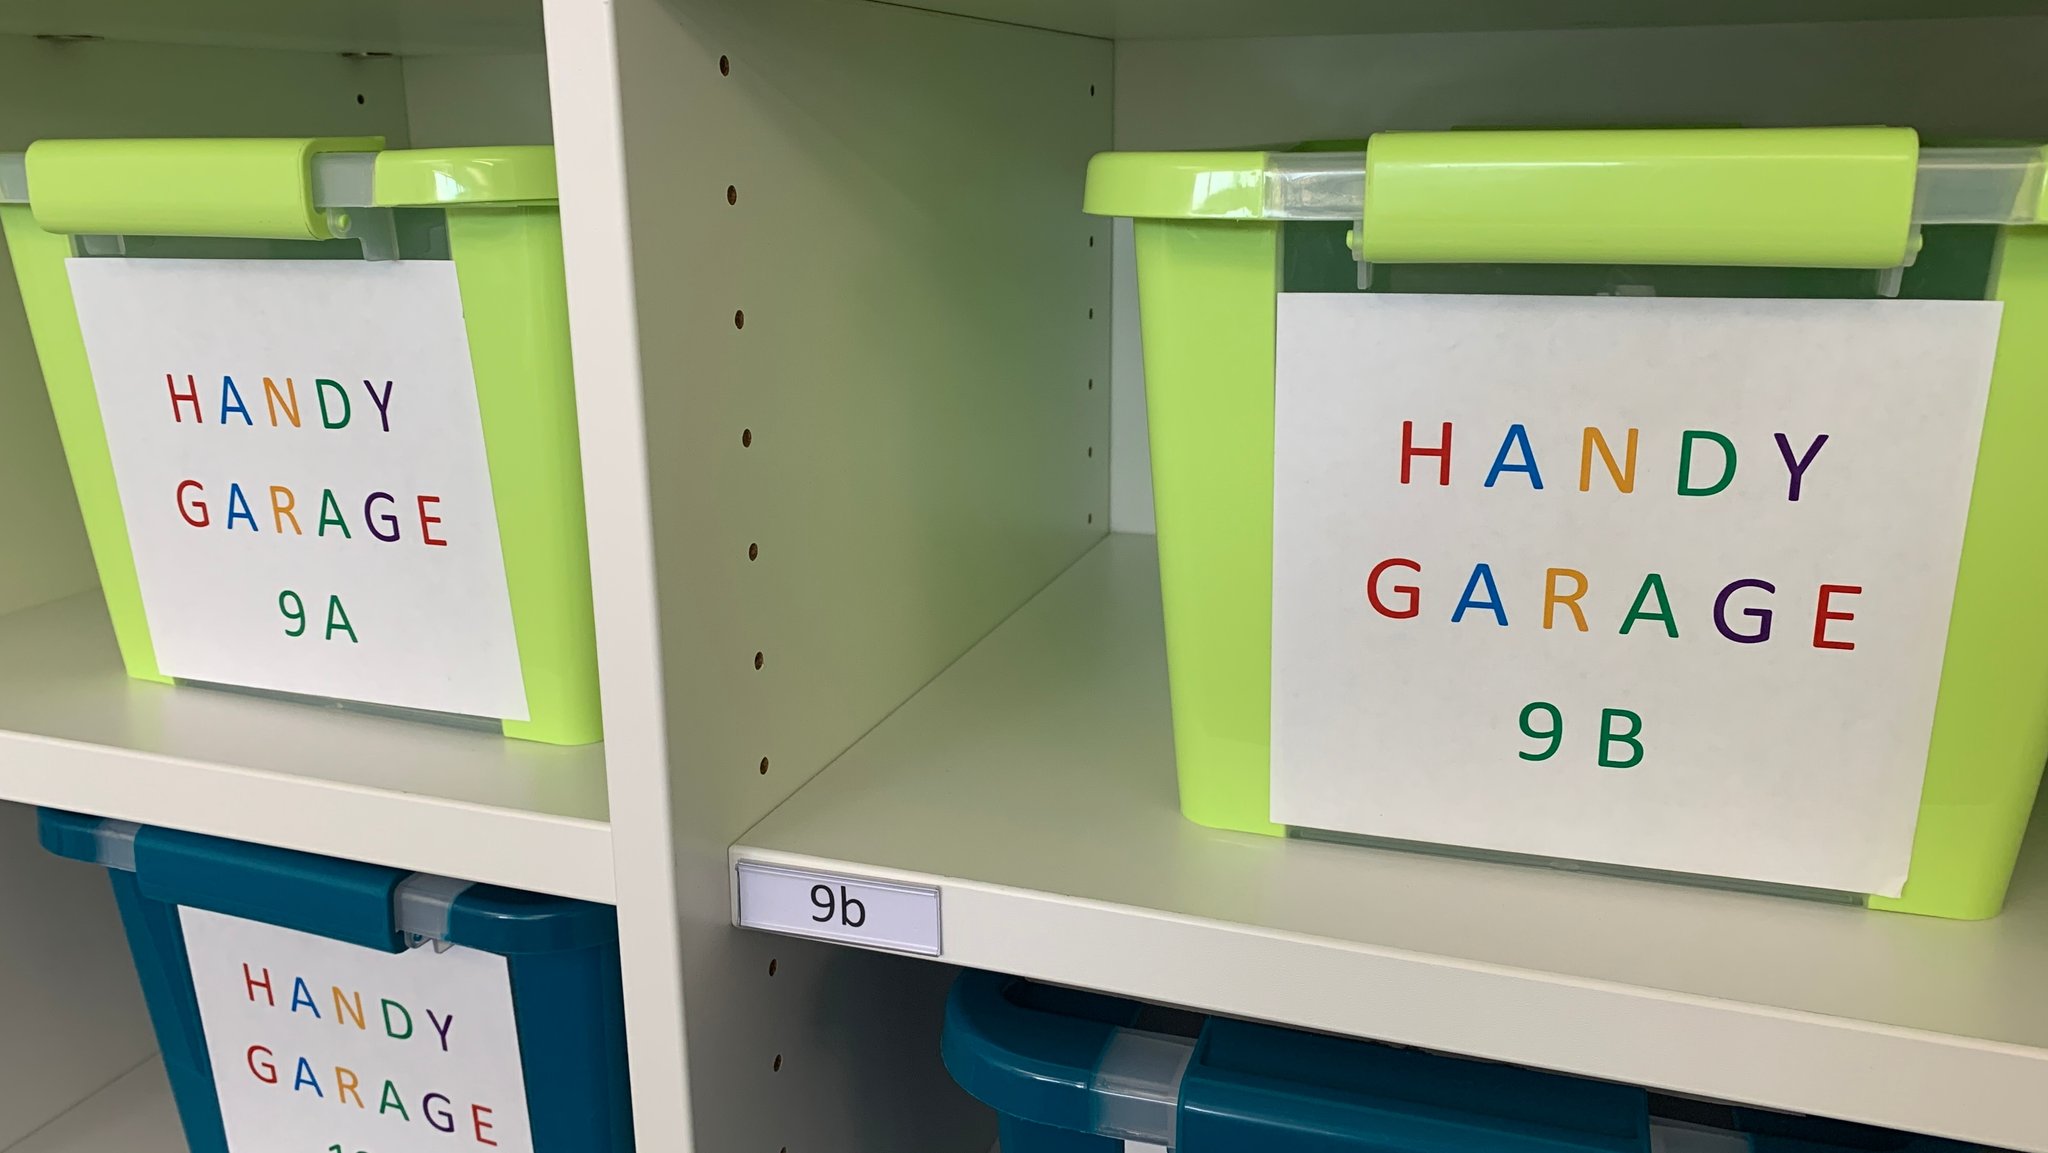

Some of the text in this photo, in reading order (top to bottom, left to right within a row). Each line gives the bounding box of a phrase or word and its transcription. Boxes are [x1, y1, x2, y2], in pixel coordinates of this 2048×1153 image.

[166, 374, 394, 432] HANDY
[1400, 421, 1829, 502] HANDY
[176, 480, 448, 546] GARAGE
[1366, 558, 1862, 651] GARAGE
[810, 884, 866, 928] 9b
[242, 963, 454, 1052] HANDY
[246, 1044, 498, 1147] GARAGE
